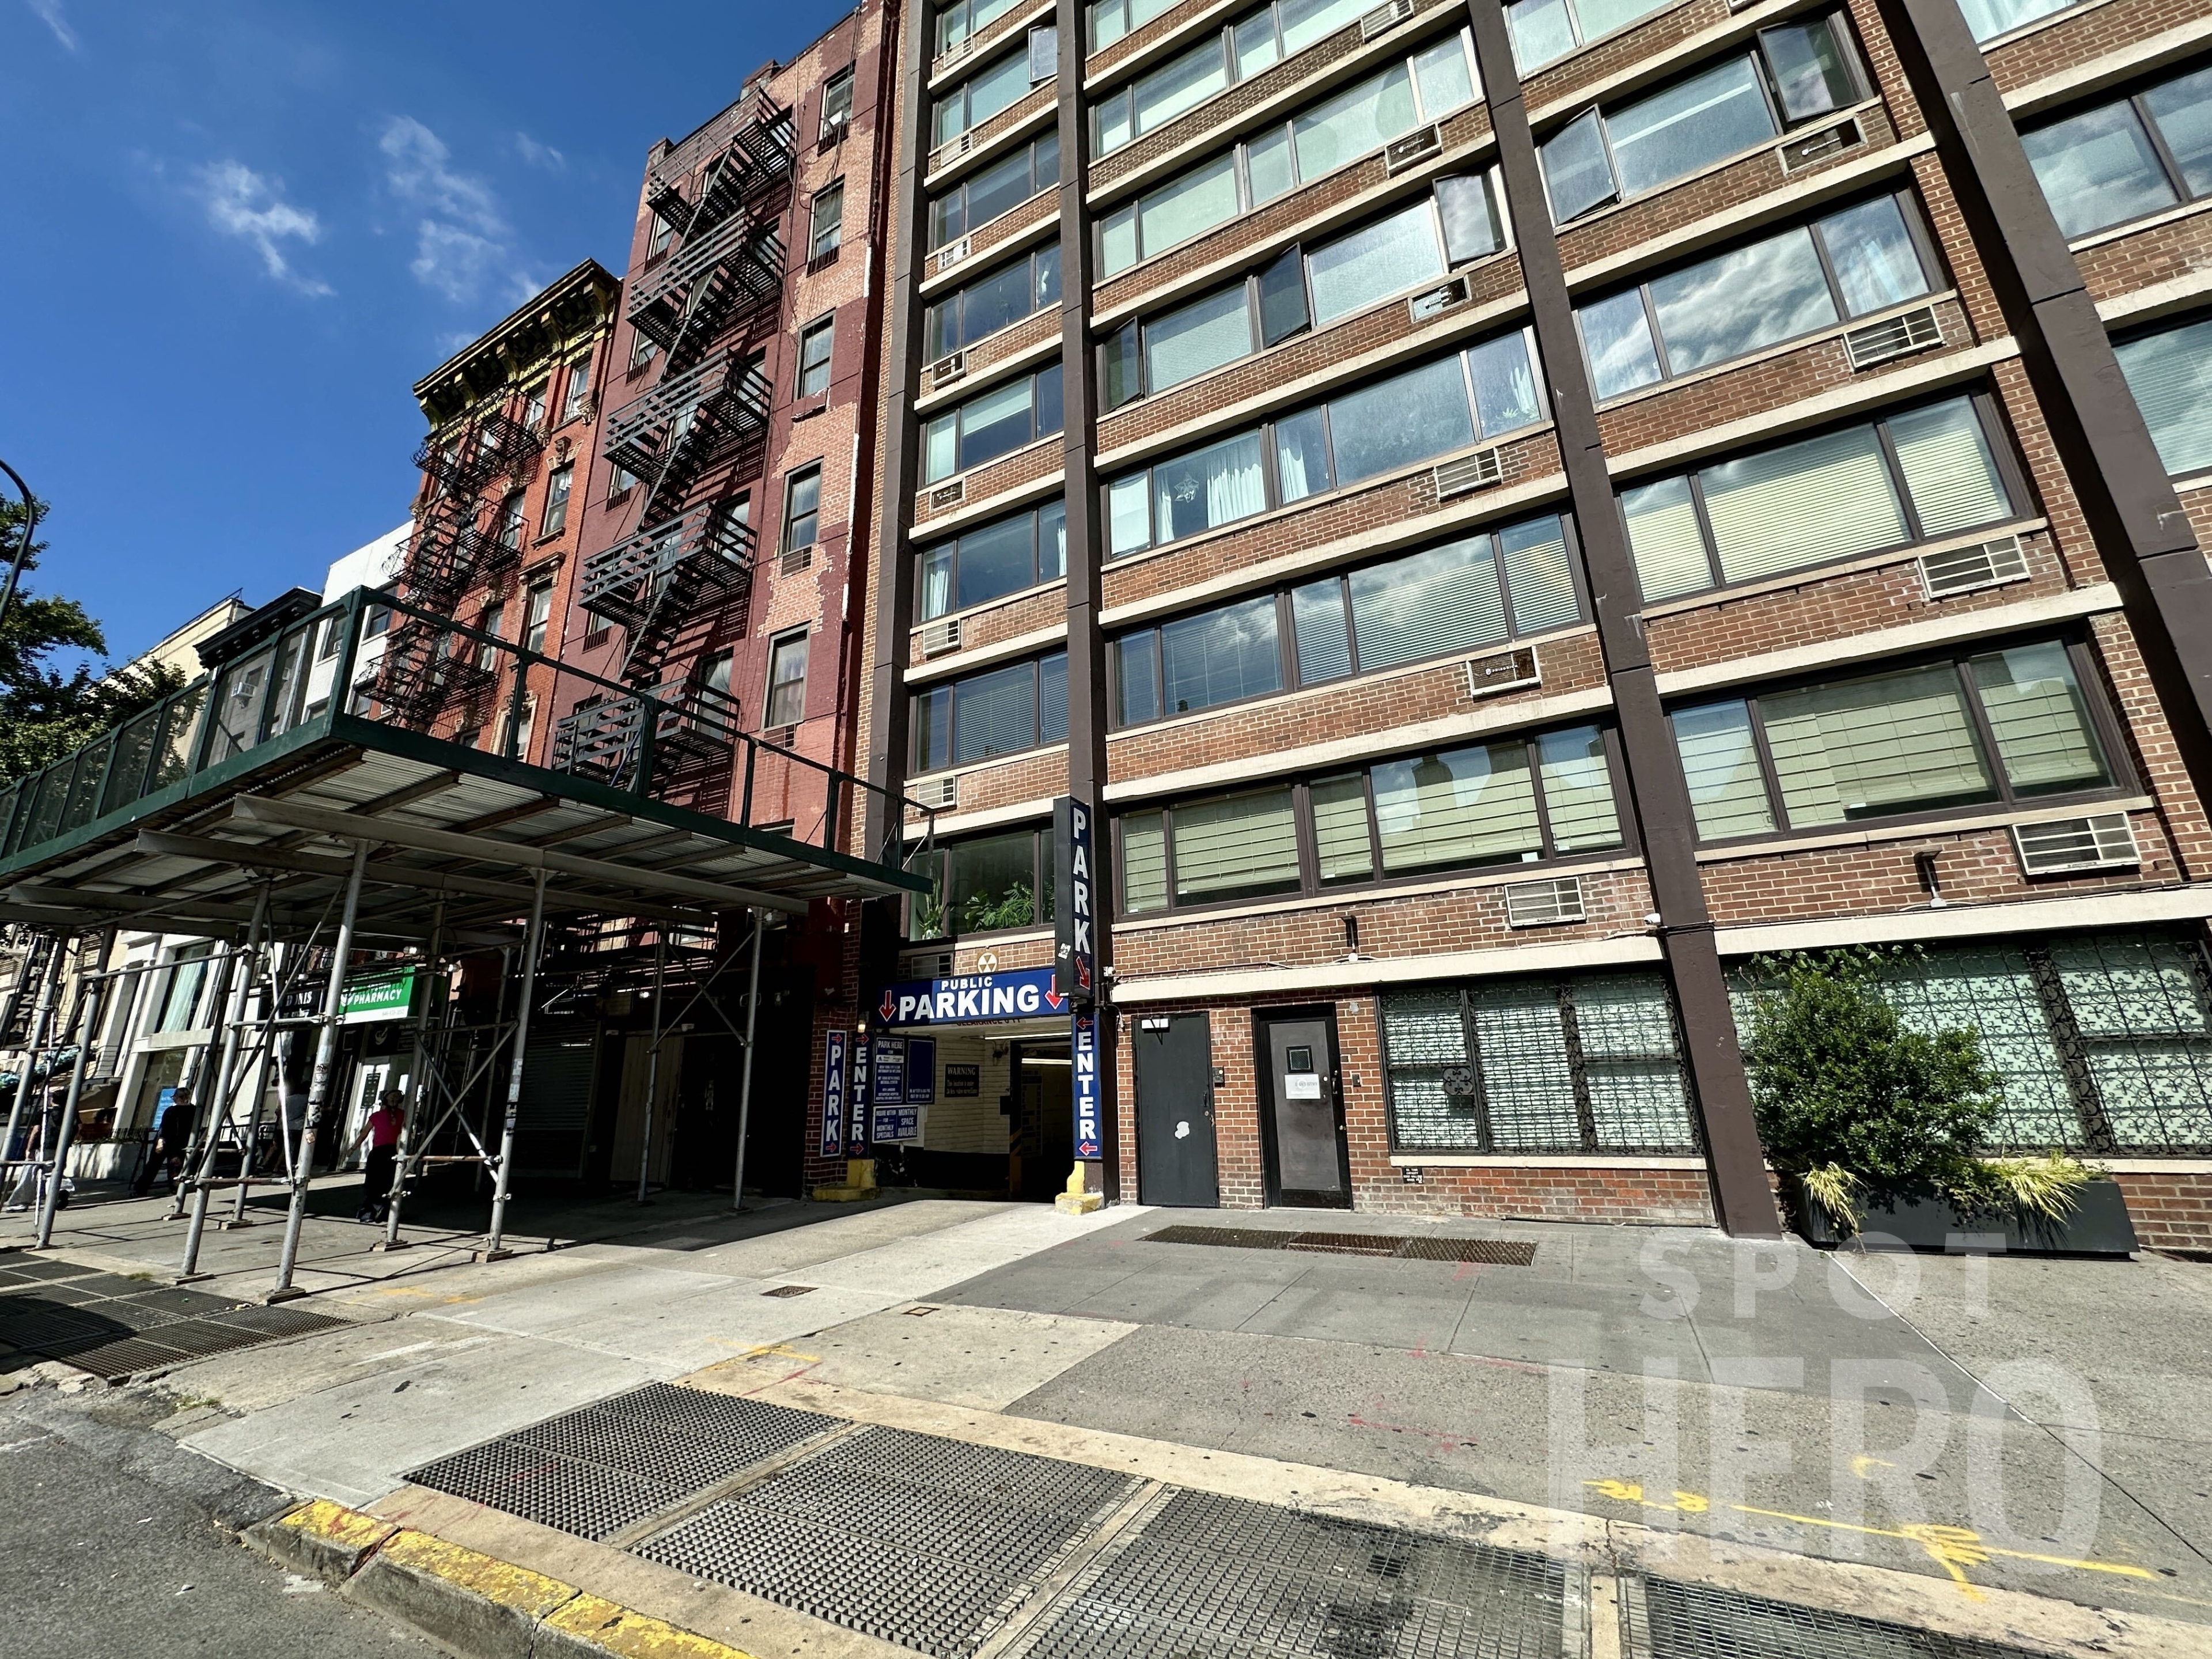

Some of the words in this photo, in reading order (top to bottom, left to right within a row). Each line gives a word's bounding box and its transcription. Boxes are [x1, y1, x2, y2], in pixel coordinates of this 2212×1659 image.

[1073, 807, 1091, 955] PARK
[353, 988, 402, 1005] PHARMACY
[941, 976, 993, 991] PUBLIC
[10, 966, 44, 1033] PIZZA
[899, 984, 1039, 1021] PARKING
[878, 1040, 891, 1048] PARK
[948, 1067, 975, 1075] WARNING
[825, 1045, 841, 1142] PARK
[851, 1047, 867, 1141] ENTER
[1077, 1032, 1096, 1139] ENTER
[897, 1126, 916, 1137] AVAILABLE
[901, 1118, 914, 1126] SPACE
